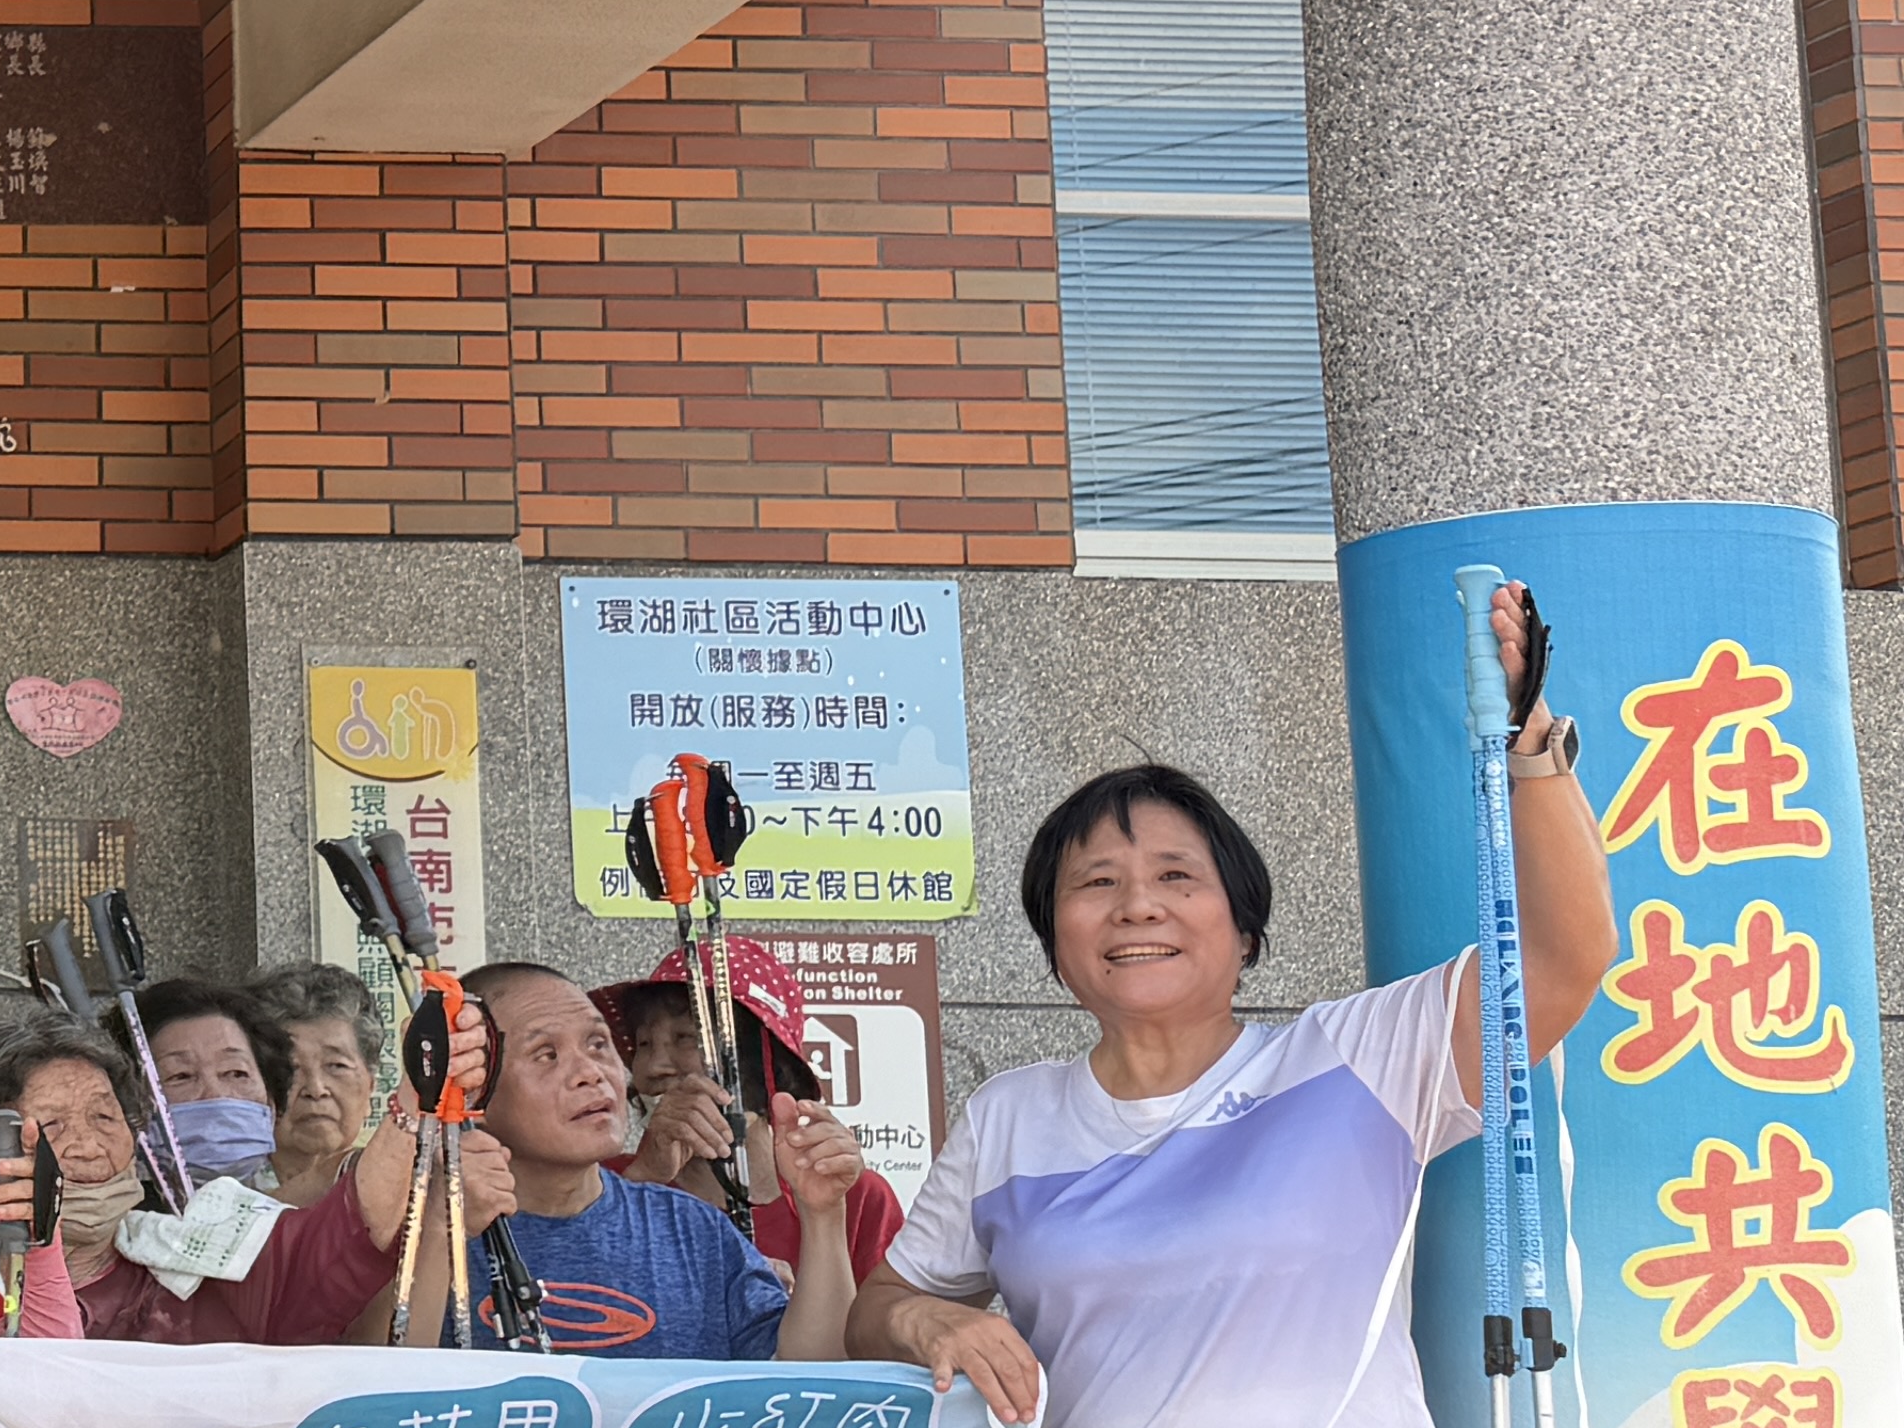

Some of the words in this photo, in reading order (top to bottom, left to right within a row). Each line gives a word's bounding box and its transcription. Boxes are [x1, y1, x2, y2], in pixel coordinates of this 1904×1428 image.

[596, 600, 927, 637] 環湖社區活動中心
[832, 986, 904, 1001] Shelter
